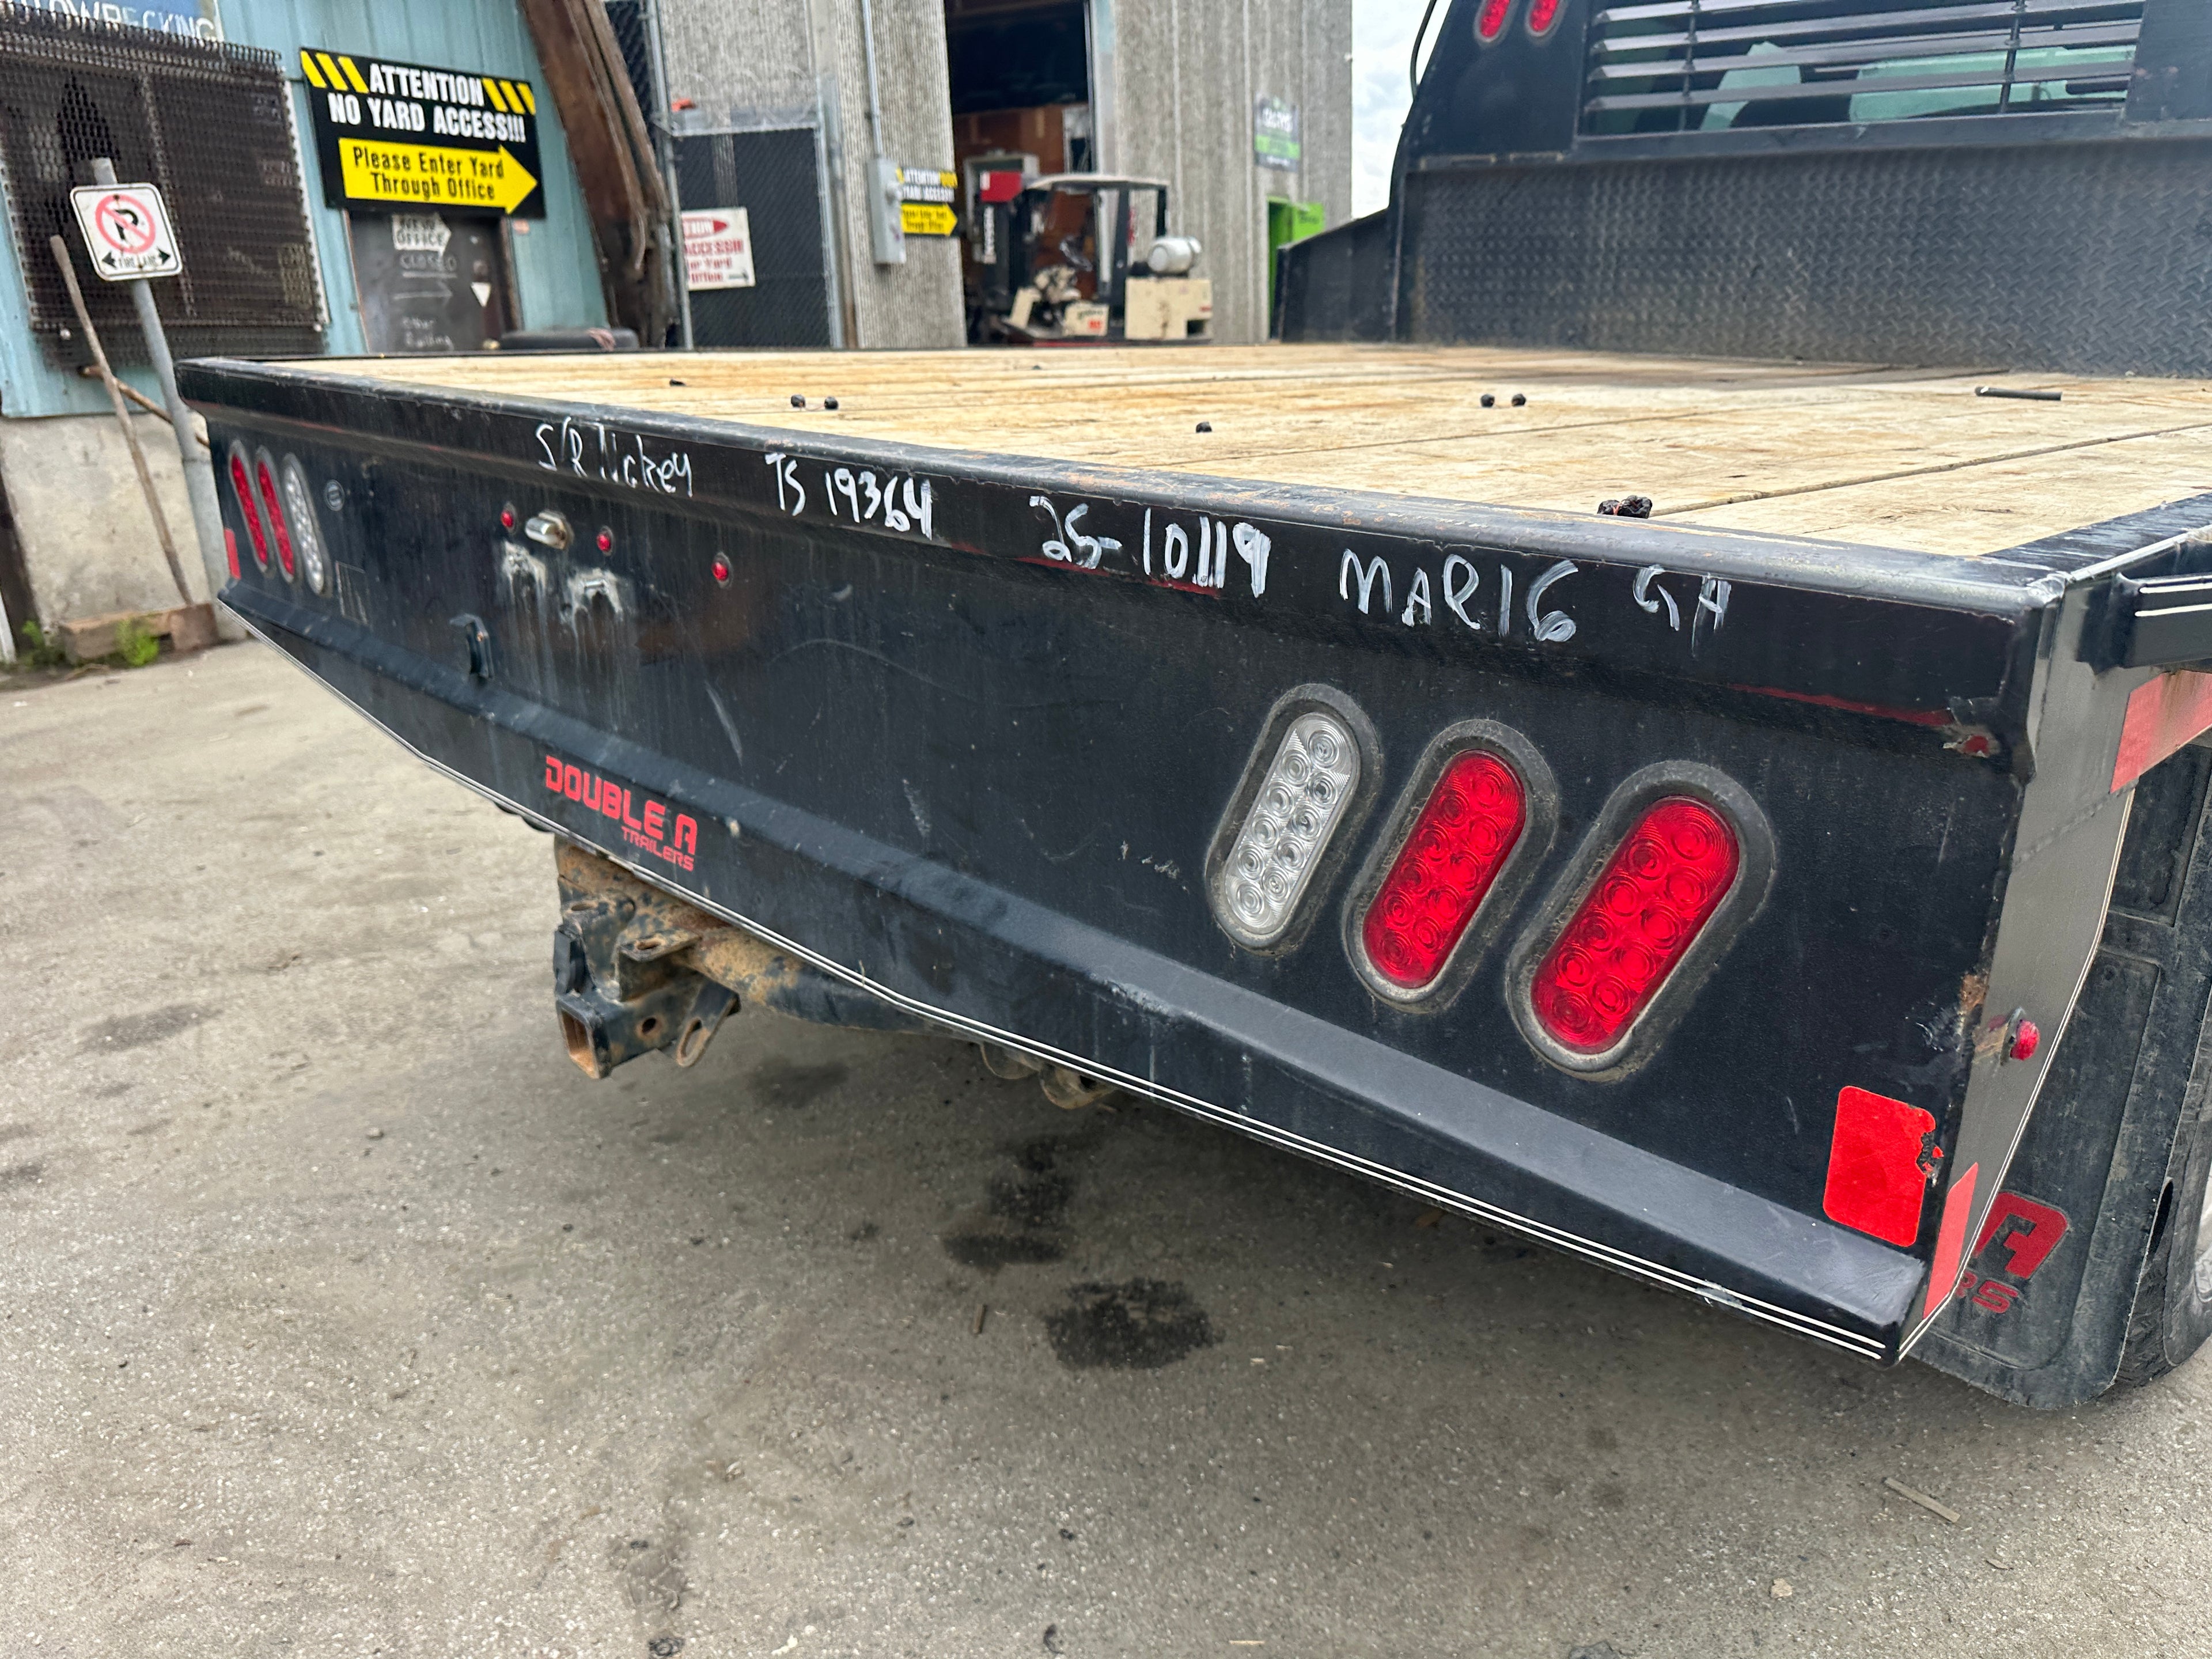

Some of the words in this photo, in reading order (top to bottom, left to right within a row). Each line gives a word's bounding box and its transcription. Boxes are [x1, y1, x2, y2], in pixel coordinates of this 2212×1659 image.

[369, 63, 484, 107] ATTENTION
[328, 92, 361, 125] NO
[367, 97, 425, 132] YARD
[433, 105, 527, 143] ACCESS!!!
[354, 146, 411, 171] Please
[419, 153, 463, 174] Enter
[469, 156, 504, 179] Yard
[370, 172, 440, 201] Through
[448, 179, 495, 200] Office
[765, 452, 806, 516] TS
[825, 467, 933, 541] 19364
[546, 755, 666, 841] DOUBLE
[674, 813, 698, 855] A
[620, 825, 695, 872] TRAILERS
